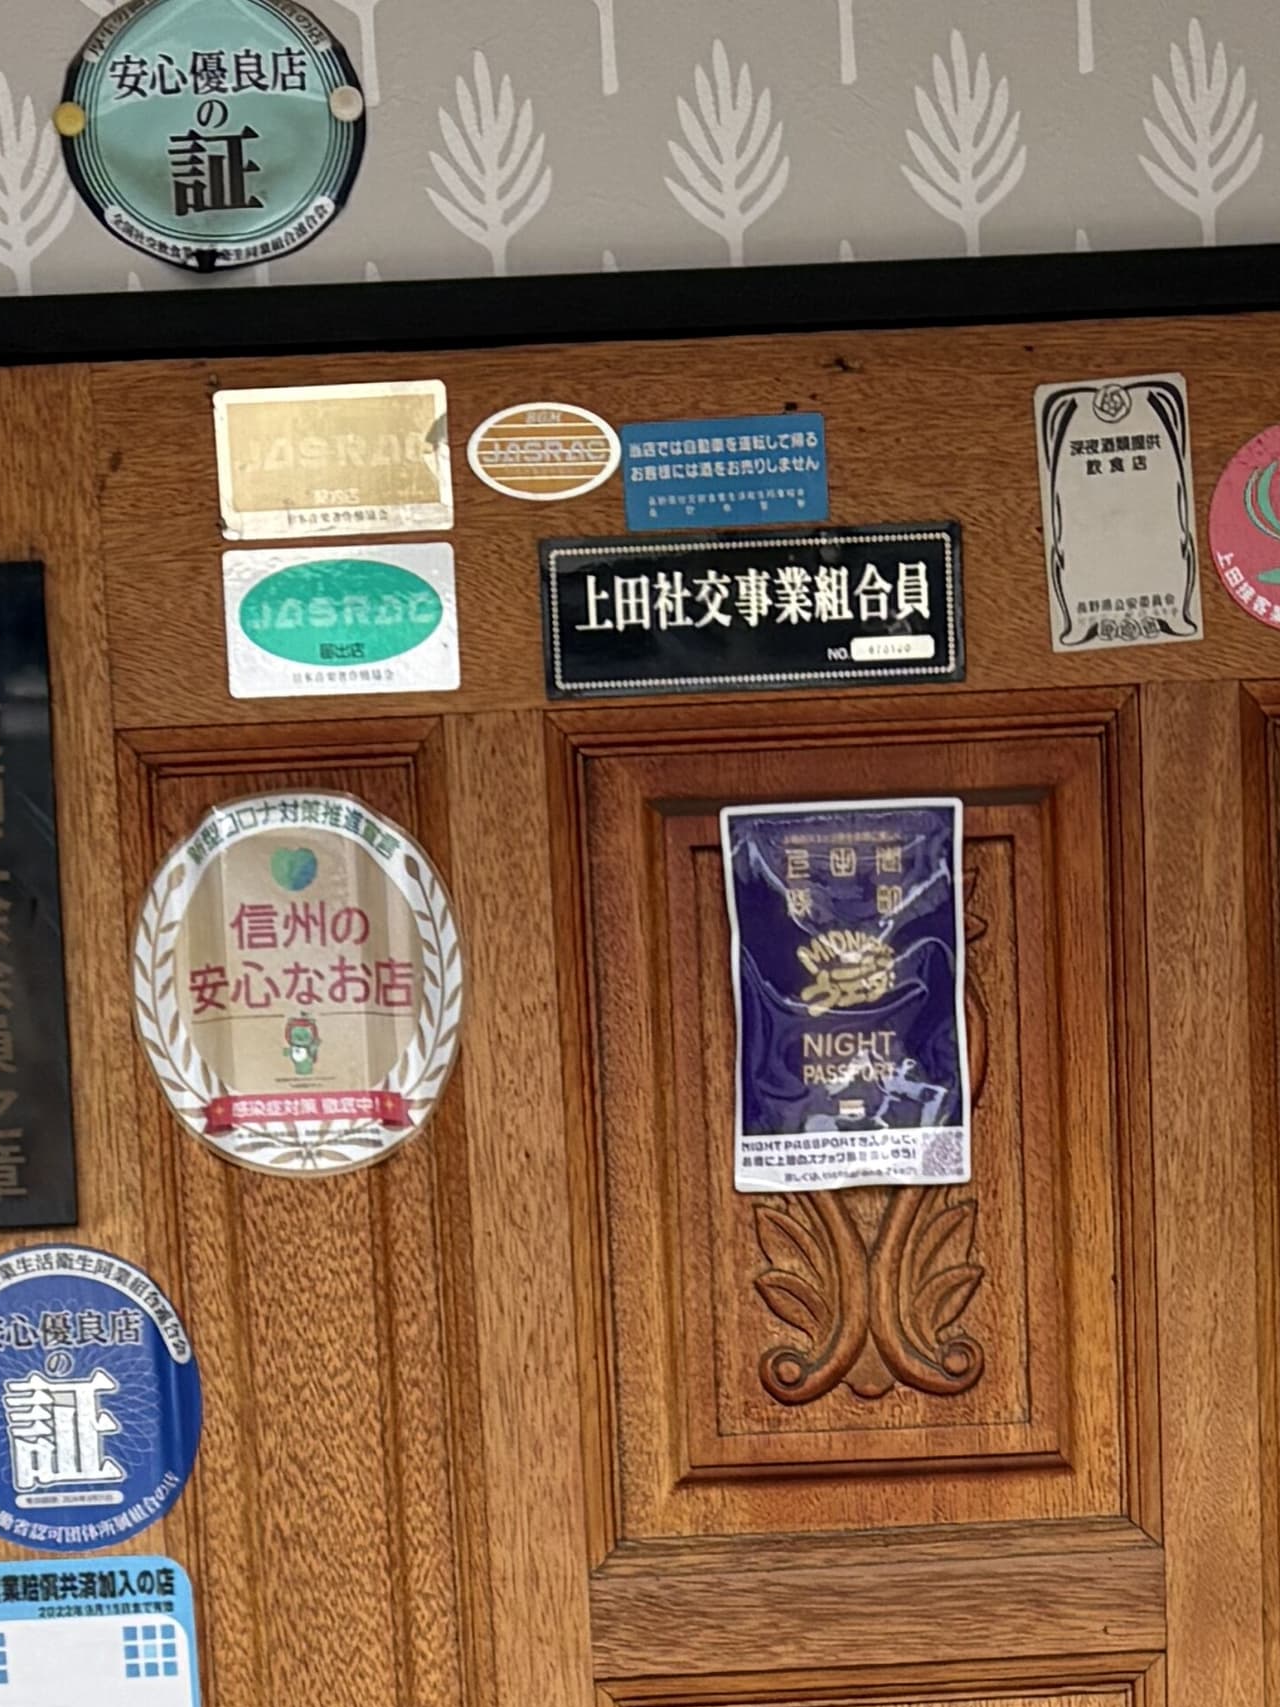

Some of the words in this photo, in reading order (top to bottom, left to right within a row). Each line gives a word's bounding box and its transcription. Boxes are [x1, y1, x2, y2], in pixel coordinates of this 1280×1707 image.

[109, 47, 307, 99] 安心優良店
[196, 99, 228, 128] の
[167, 126, 265, 217] 証
[238, 432, 432, 473] JASRAC
[482, 440, 607, 463] JASRAC
[628, 432, 819, 459] 当店では自動車を運転して帰る
[1070, 433, 1162, 457] 深夜酒類提供
[630, 456, 820, 483] お客様には酒をお売りしません
[1086, 455, 1148, 476] 飲食店
[246, 591, 435, 631] JASRAC
[575, 561, 931, 631] 上田社交事業組合員
[186, 799, 401, 866] 新型コロナ対策推進宣言
[230, 901, 371, 950] 信州の
[188, 955, 413, 1015] 安心なお店
[803, 1031, 897, 1058] NIGHT
[803, 1063, 897, 1086] PASSPORT
[46, 1352, 72, 1375] の
[4, 1369, 126, 1492] 証
